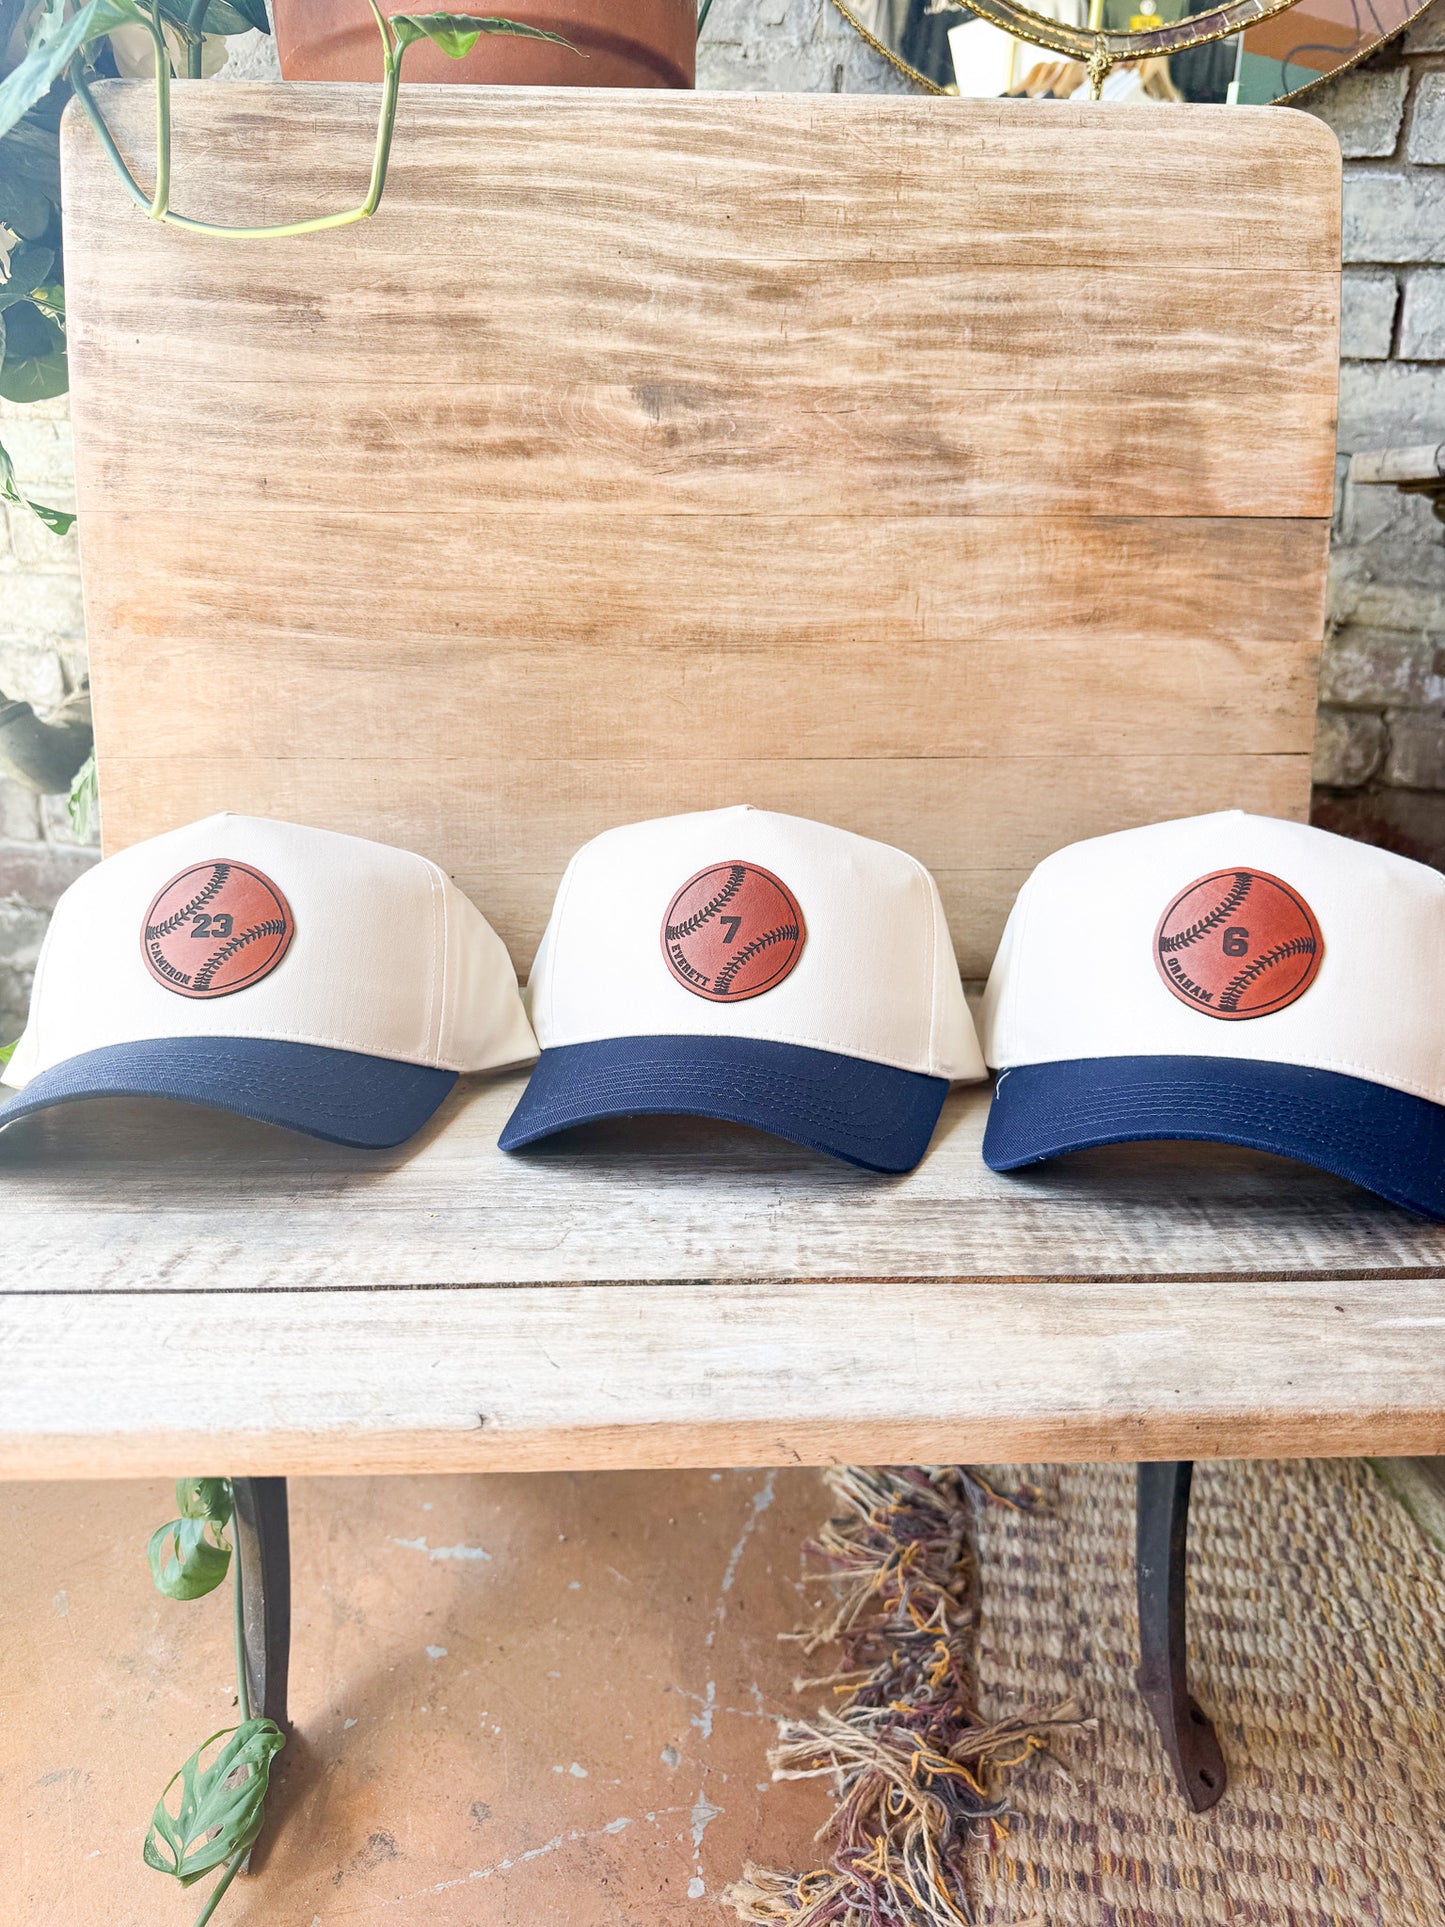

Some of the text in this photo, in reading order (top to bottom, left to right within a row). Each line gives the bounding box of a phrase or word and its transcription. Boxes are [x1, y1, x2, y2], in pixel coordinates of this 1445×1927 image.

[191, 913, 234, 938] 23
[720, 916, 742, 944] 7
[1222, 926, 1249, 957] 6
[150, 942, 192, 985] CAMERON
[671, 943, 710, 986] EVERETT
